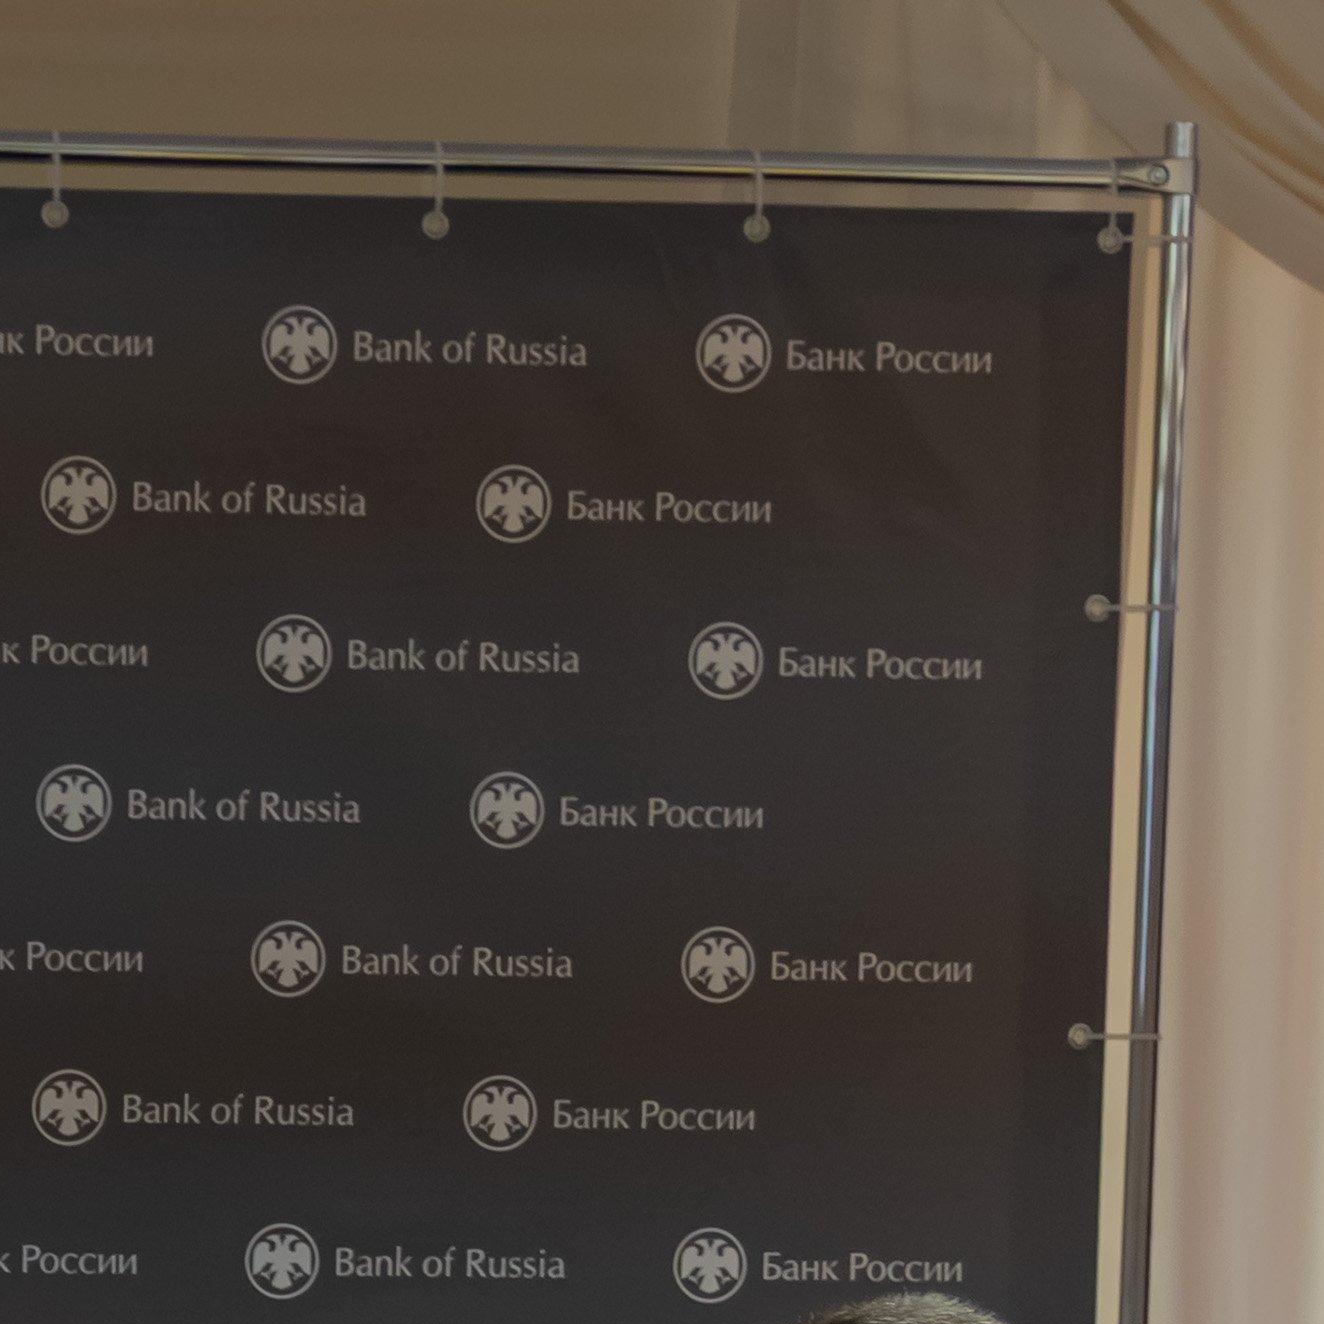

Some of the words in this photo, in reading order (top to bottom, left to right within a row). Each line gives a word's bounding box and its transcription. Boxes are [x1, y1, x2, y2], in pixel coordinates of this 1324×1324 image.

[35, 323, 154, 357] России
[353, 329, 432, 363] Bank
[442, 330, 477, 364] of
[486, 333, 587, 367] Russia
[786, 339, 865, 371] Банк
[876, 340, 992, 374] России
[567, 489, 644, 522] Банк
[655, 491, 772, 524] России
[31, 633, 148, 667] России
[560, 796, 638, 827] Банк
[648, 796, 764, 829] России
[342, 943, 420, 975] Bank
[429, 944, 463, 977] of
[472, 946, 573, 978] Russia
[771, 950, 847, 982] Банк
[857, 951, 973, 983] России
[21, 1244, 138, 1275] России
